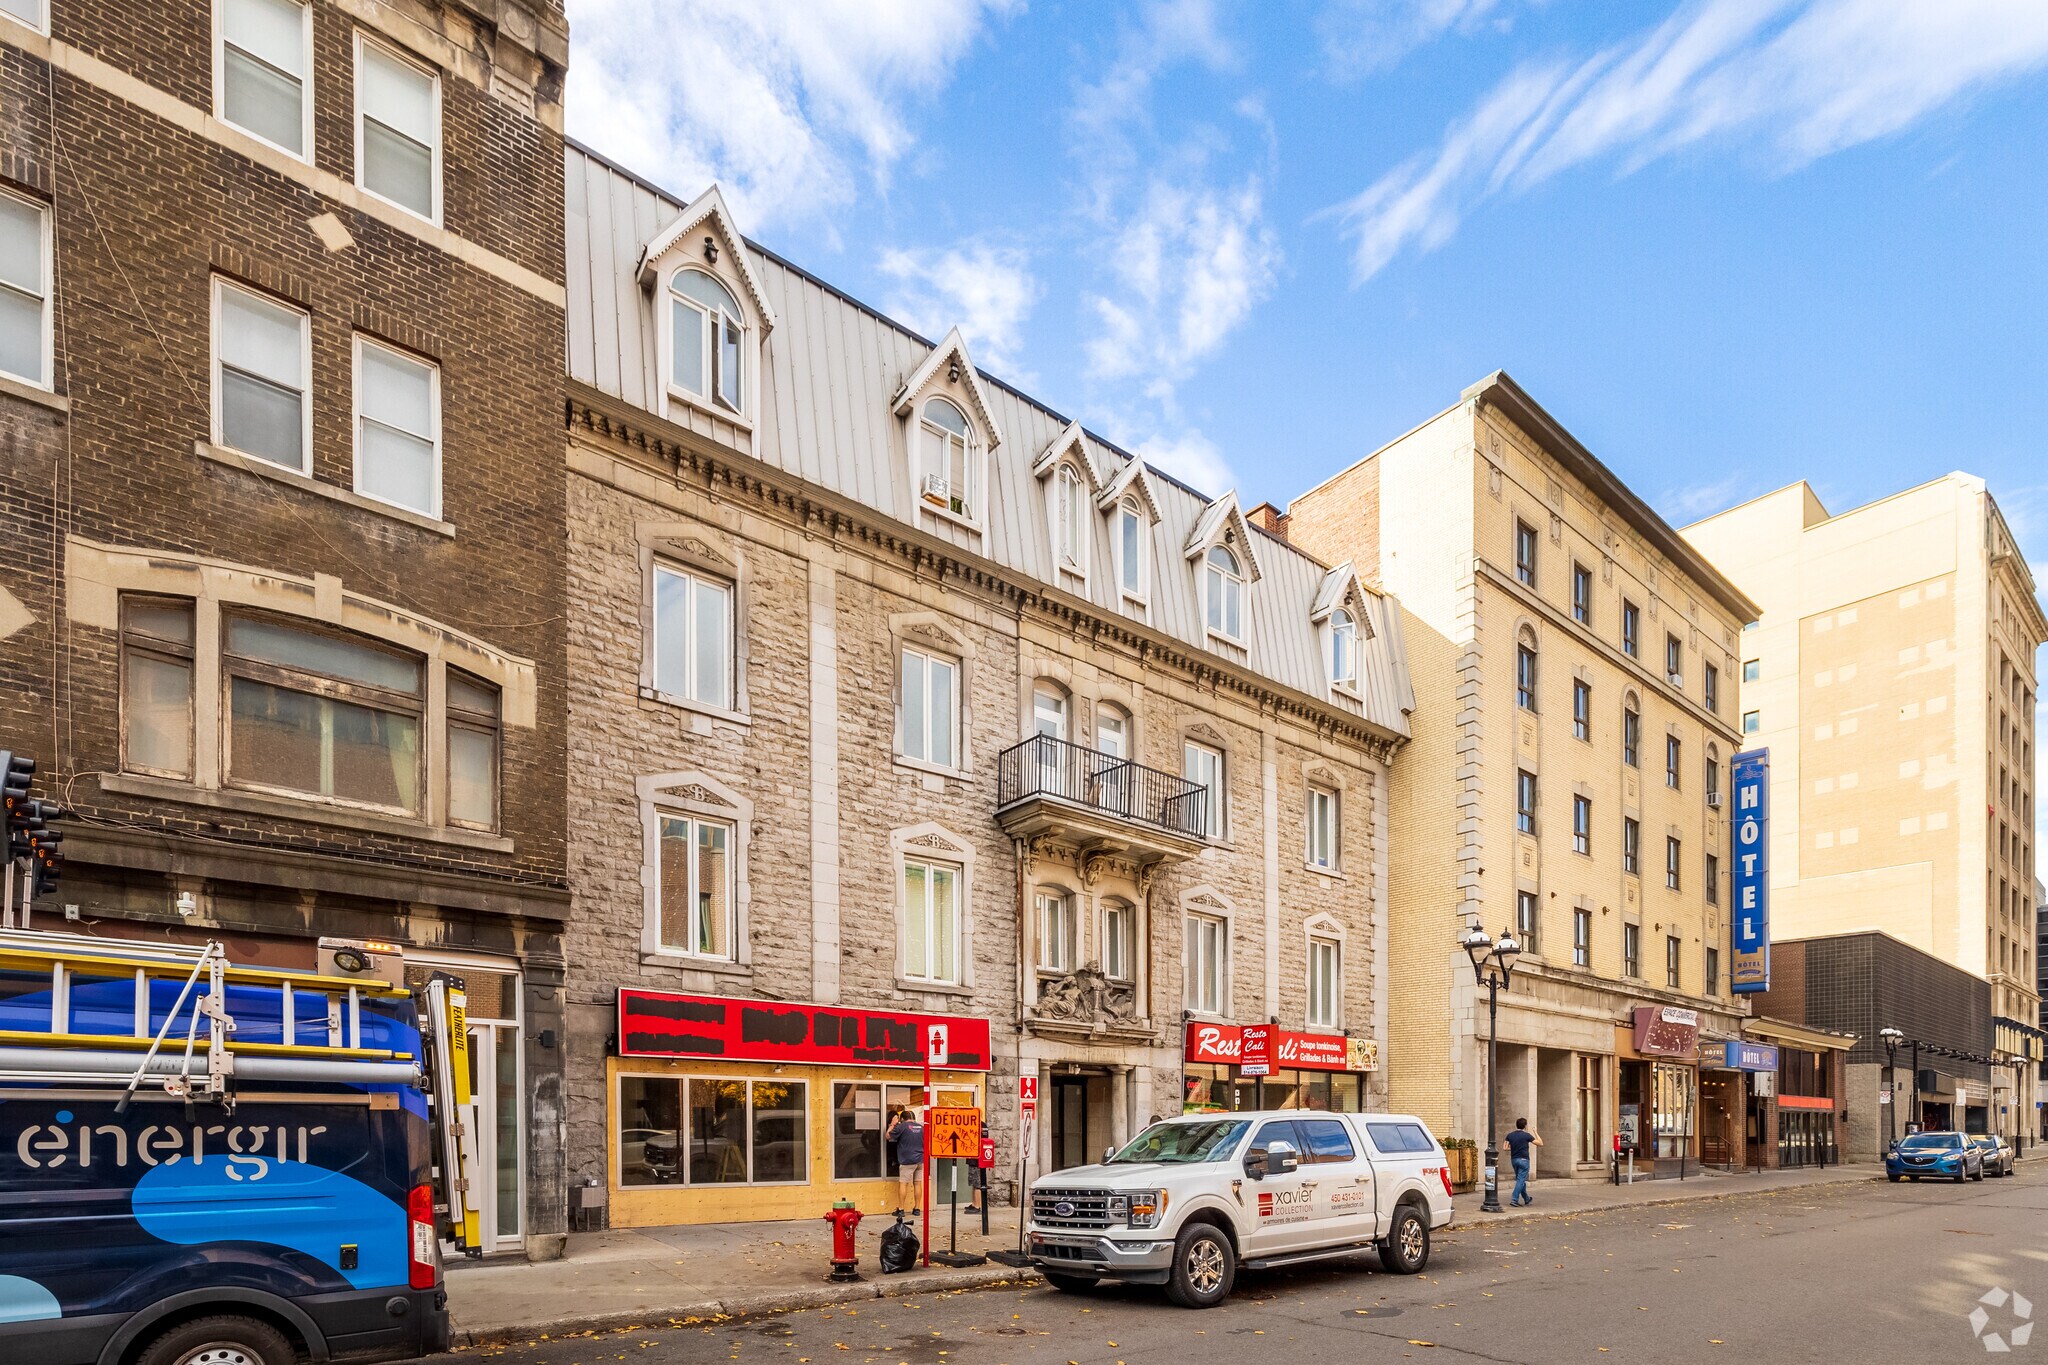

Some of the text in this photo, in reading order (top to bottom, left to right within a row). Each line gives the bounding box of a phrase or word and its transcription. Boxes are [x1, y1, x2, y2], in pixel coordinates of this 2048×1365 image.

[1740, 784, 1759, 941] HÔTEL
[453, 1005, 465, 1051] FEATHERLITE
[1243, 1028, 1267, 1039] Resto
[1198, 1027, 1242, 1057] Rest
[1244, 1040, 1265, 1053] Cali
[1300, 1040, 1342, 1053] Soupe tonkinoise,
[1704, 1047, 1724, 1055] HÔTEL
[1742, 1049, 1760, 1064] HÔTEL
[1300, 1052, 1322, 1063] Grillades
[1322, 1054, 1327, 1063] &
[1340, 1055, 1346, 1064] mi
[935, 1111, 978, 1127] DÉTOUR
[1275, 1187, 1313, 1205] xavier
[1331, 1193, 1341, 1203] 450
[1275, 1205, 1314, 1216] COLLECTION
